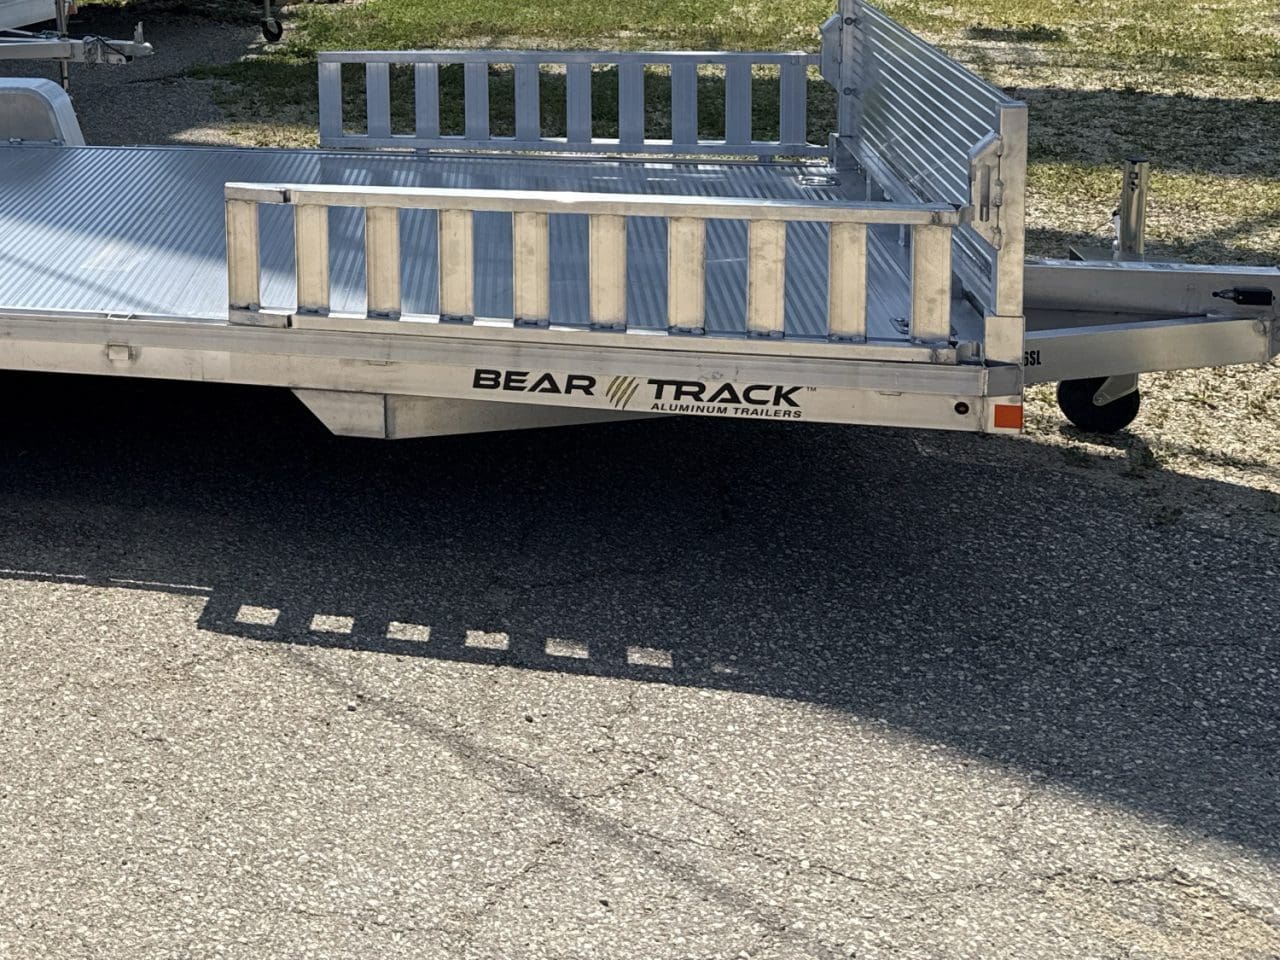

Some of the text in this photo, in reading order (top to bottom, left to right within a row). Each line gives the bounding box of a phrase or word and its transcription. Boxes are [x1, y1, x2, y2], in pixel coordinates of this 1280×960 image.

[472, 368, 597, 396] BEAR
[647, 379, 804, 408] TRACK
[651, 403, 802, 419] ALUMINUM TRAILERS
